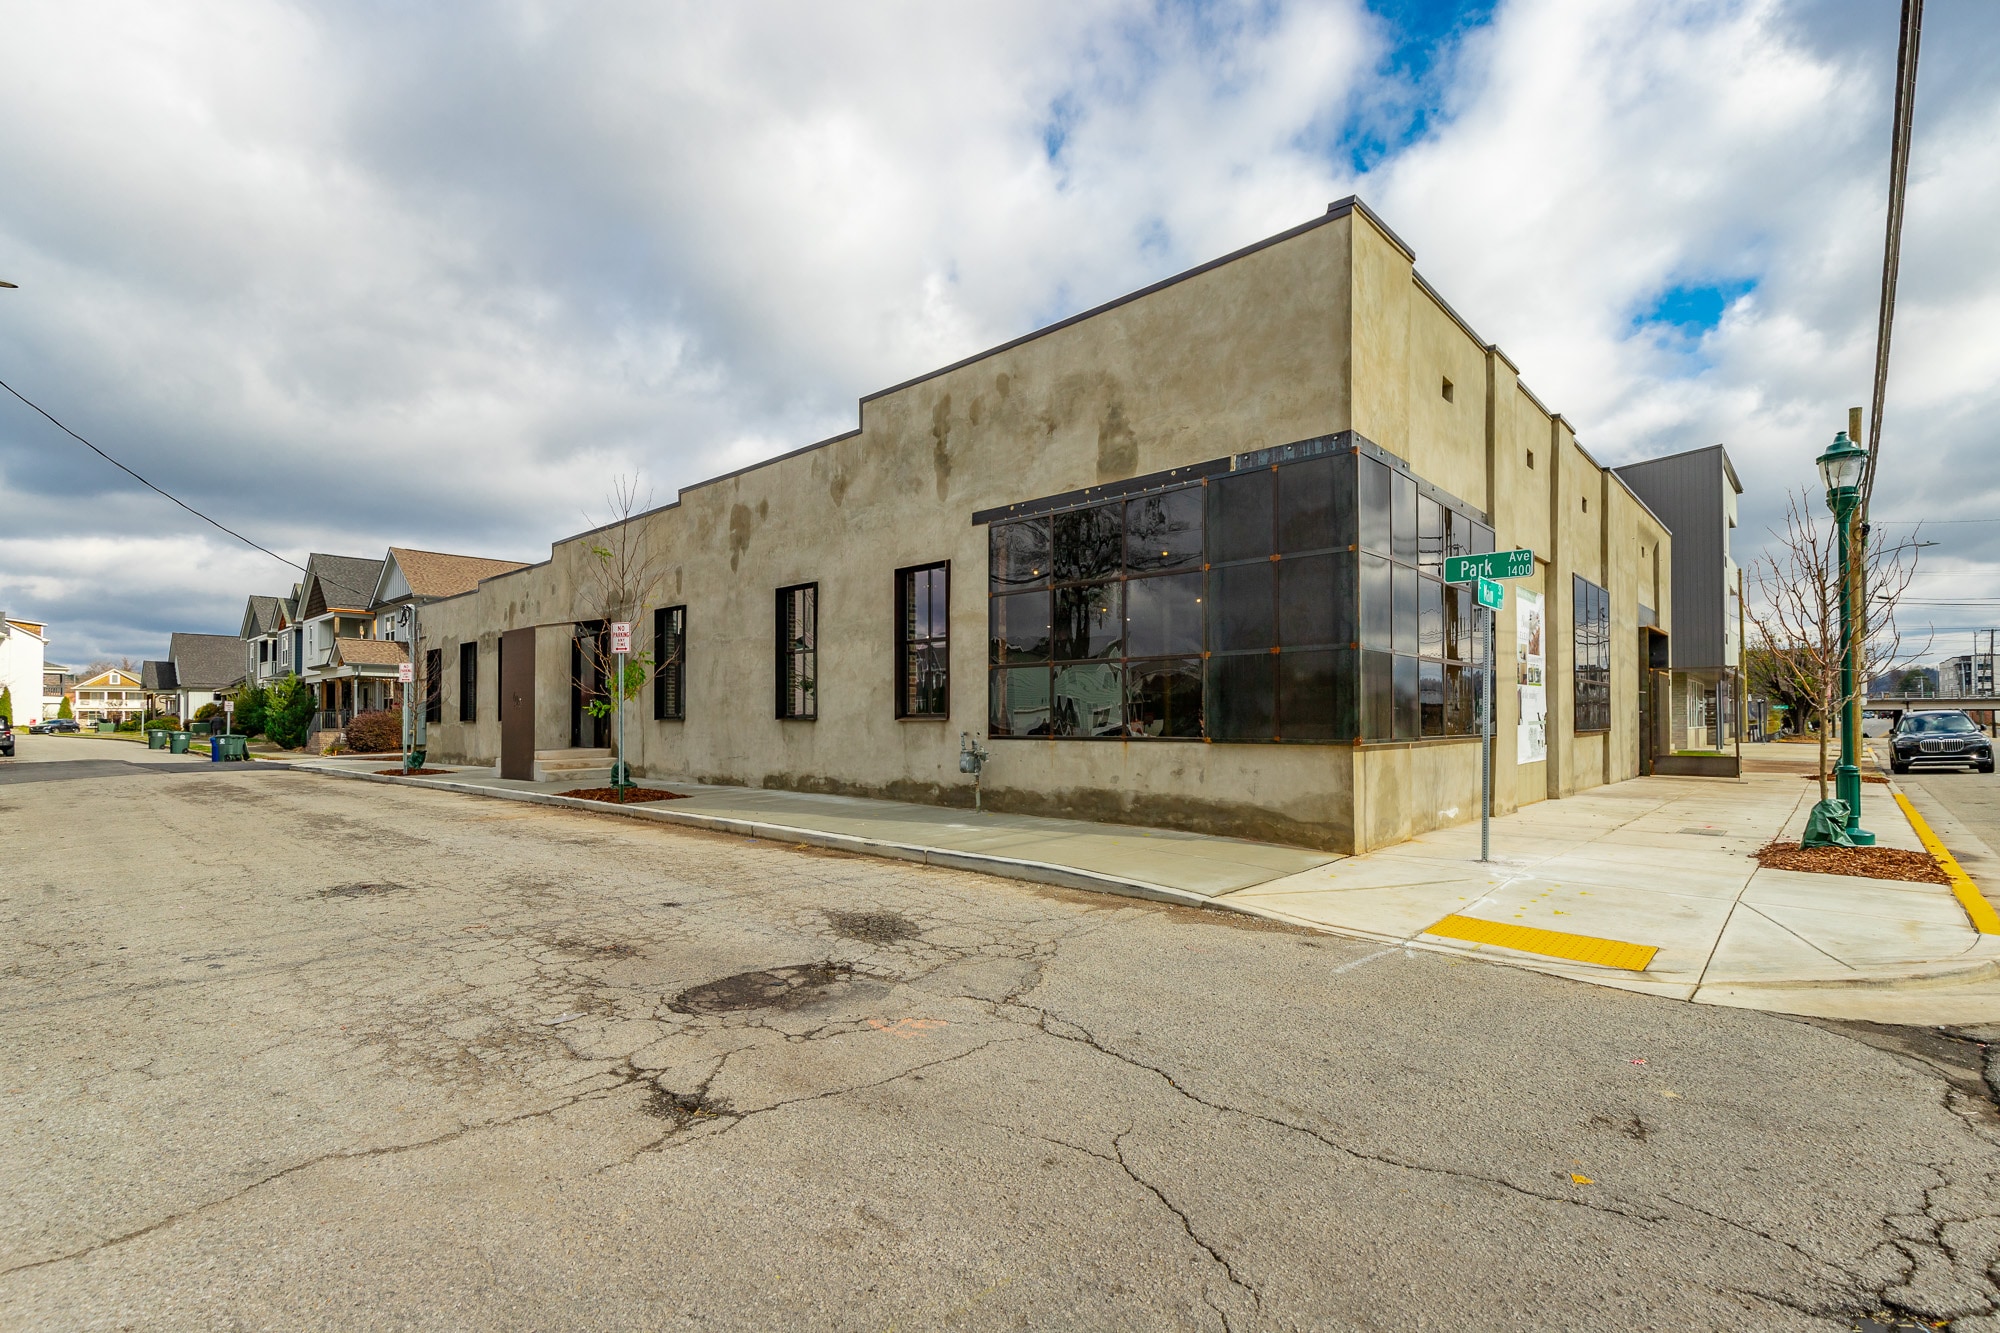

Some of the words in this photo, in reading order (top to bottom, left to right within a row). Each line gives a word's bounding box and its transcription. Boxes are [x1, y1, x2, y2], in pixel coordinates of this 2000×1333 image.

[1460, 559, 1493, 578] Park
[1509, 552, 1530, 563] Ave
[1508, 564, 1531, 577] 1400
